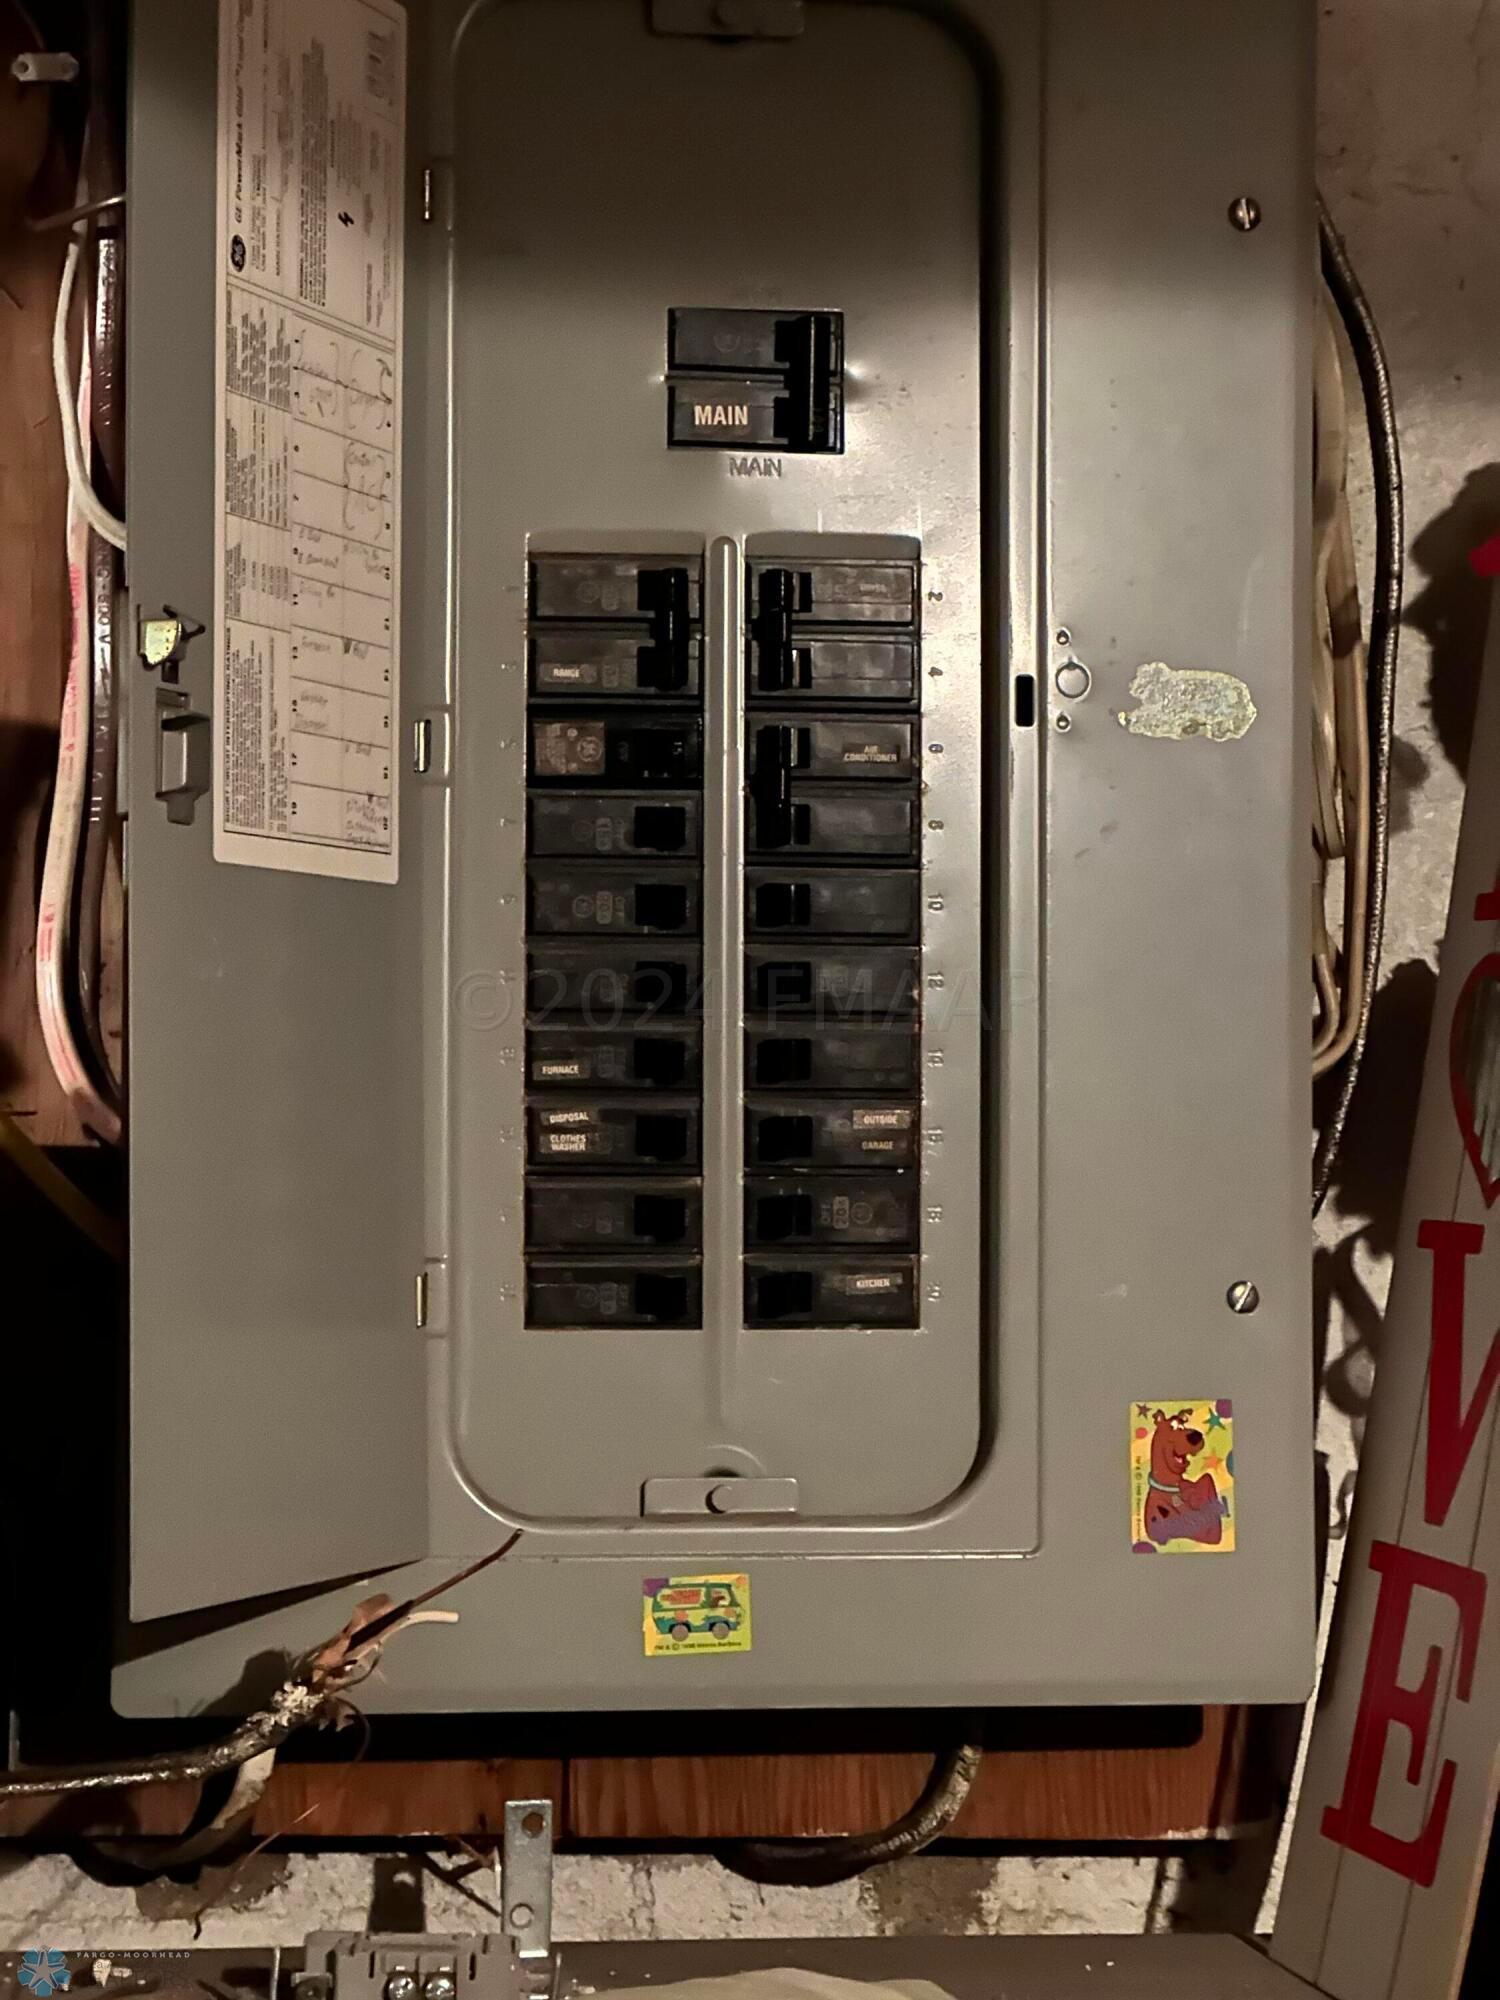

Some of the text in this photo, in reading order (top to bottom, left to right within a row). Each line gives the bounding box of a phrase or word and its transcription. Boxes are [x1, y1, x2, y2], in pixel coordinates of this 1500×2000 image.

[693, 403, 749, 427] MAIN
[728, 457, 783, 477] MAIN
[552, 667, 581, 679] RANGE
[541, 1063, 580, 1076] FURNACE
[548, 1111, 590, 1124] DISPOSAL
[863, 1114, 898, 1126] OUTSIDE
[549, 1133, 587, 1144] CLOTHES
[861, 1139, 894, 1151] GARAGE
[855, 1277, 892, 1290] KITCHEN
